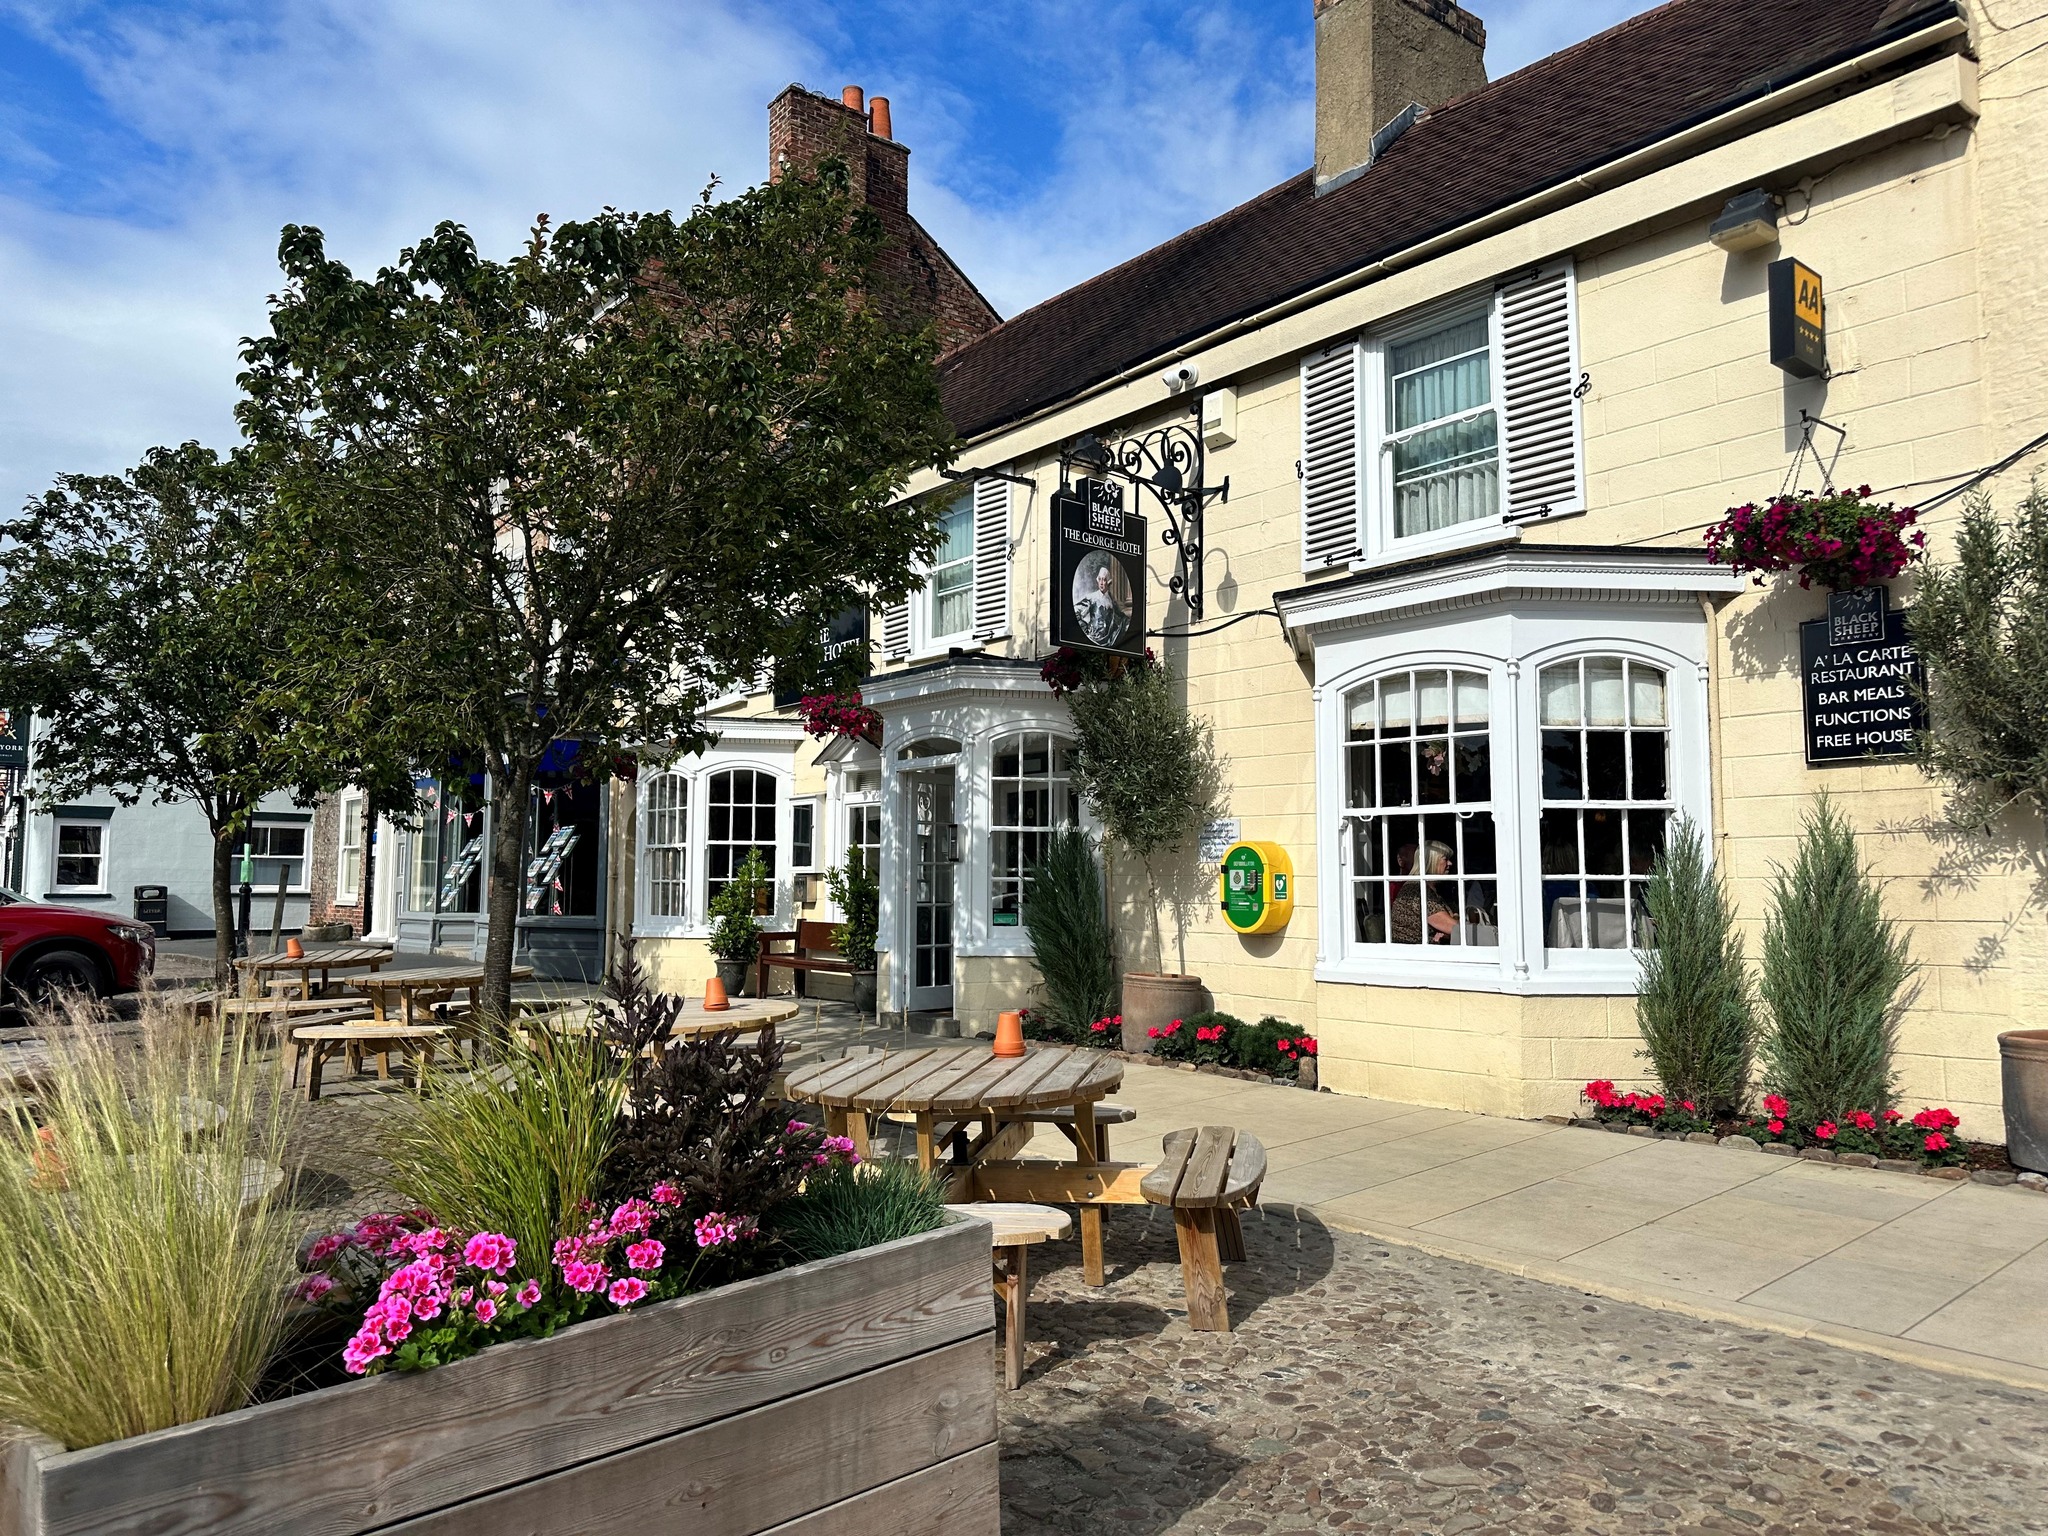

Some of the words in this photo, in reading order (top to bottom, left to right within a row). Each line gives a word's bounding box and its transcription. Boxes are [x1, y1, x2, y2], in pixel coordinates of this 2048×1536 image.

[1798, 279, 1819, 315] AA
[1092, 502, 1121, 518] BLACK
[1092, 512, 1121, 527] SHEEP
[1063, 527, 1081, 541] THE
[1082, 532, 1115, 549] GEORGE
[1116, 540, 1142, 555] HOTEL
[1834, 611, 1878, 626] BLACK
[1834, 622, 1879, 637] SHEEP
[1834, 632, 1879, 642] BREWERY
[1833, 652, 1853, 666] LA
[1857, 646, 1911, 663] CARTE
[1811, 661, 1915, 685] RESTAURANT
[1818, 691, 1849, 706] BAR
[1853, 685, 1905, 702] MEALS
[1815, 706, 1912, 727] FUNCTIONS
[1816, 733, 1852, 748] FREE
[1855, 729, 1913, 745] HOUSE
